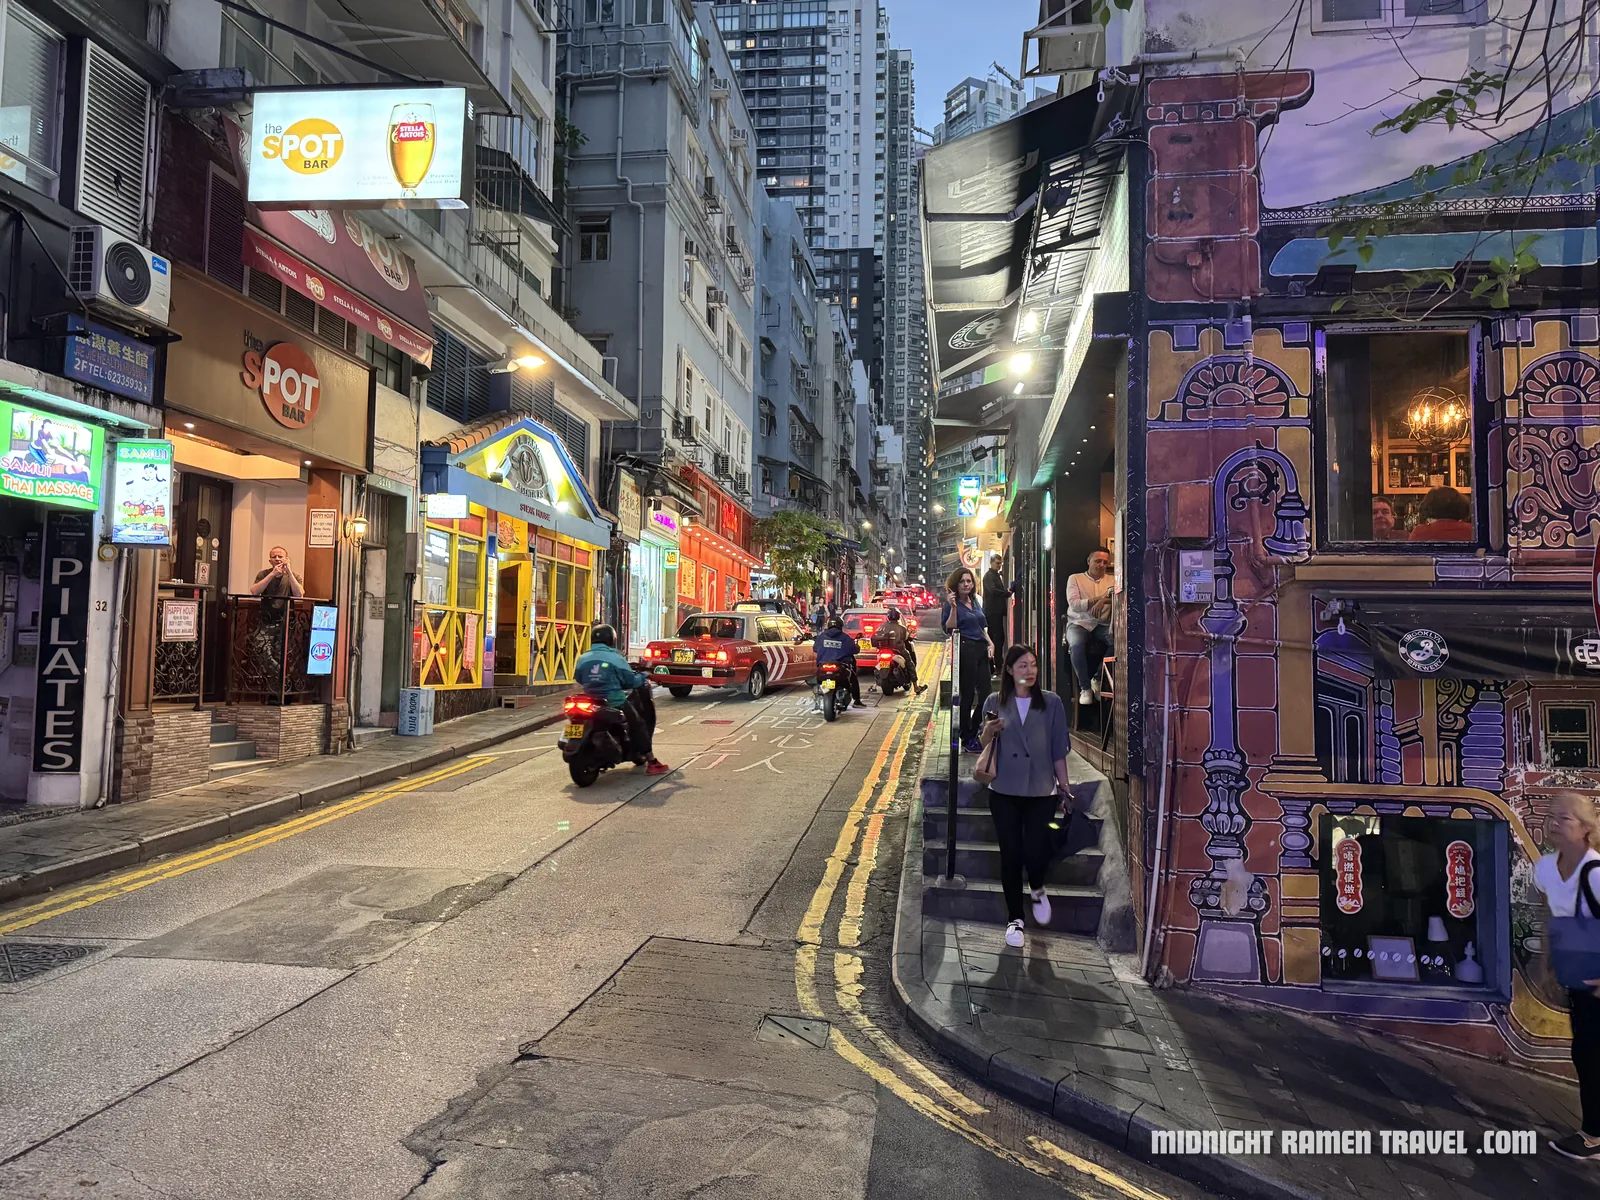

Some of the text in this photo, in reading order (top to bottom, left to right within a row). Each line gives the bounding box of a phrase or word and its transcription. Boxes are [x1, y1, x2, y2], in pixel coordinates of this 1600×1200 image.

[265, 123, 282, 134] the
[262, 134, 342, 160] SPOT
[303, 160, 329, 169] BAR
[255, 246, 298, 279] STELLA ARTOIS
[383, 265, 404, 286] BAR
[333, 295, 351, 310] STELLA
[354, 307, 370, 322] ARTOIS
[74, 358, 88, 372] 2F
[243, 351, 320, 411] SPOT
[282, 403, 306, 424] BAR
[119, 447, 169, 460] SAMUI
[1, 457, 52, 477] SAMUI
[3, 475, 94, 501] THAI MASSAGE
[520, 503, 551, 521] STEAK HOUSE
[95, 601, 107, 612] 32
[1404, 631, 1443, 644] BROOKLYN
[312, 646, 331, 657] AFL
[42, 557, 84, 770] PILATES
[1407, 659, 1443, 671] BREWERY
[745, 716, 828, 730] PED
[712, 730, 815, 749] 小心
[677, 749, 786, 774] 行人
